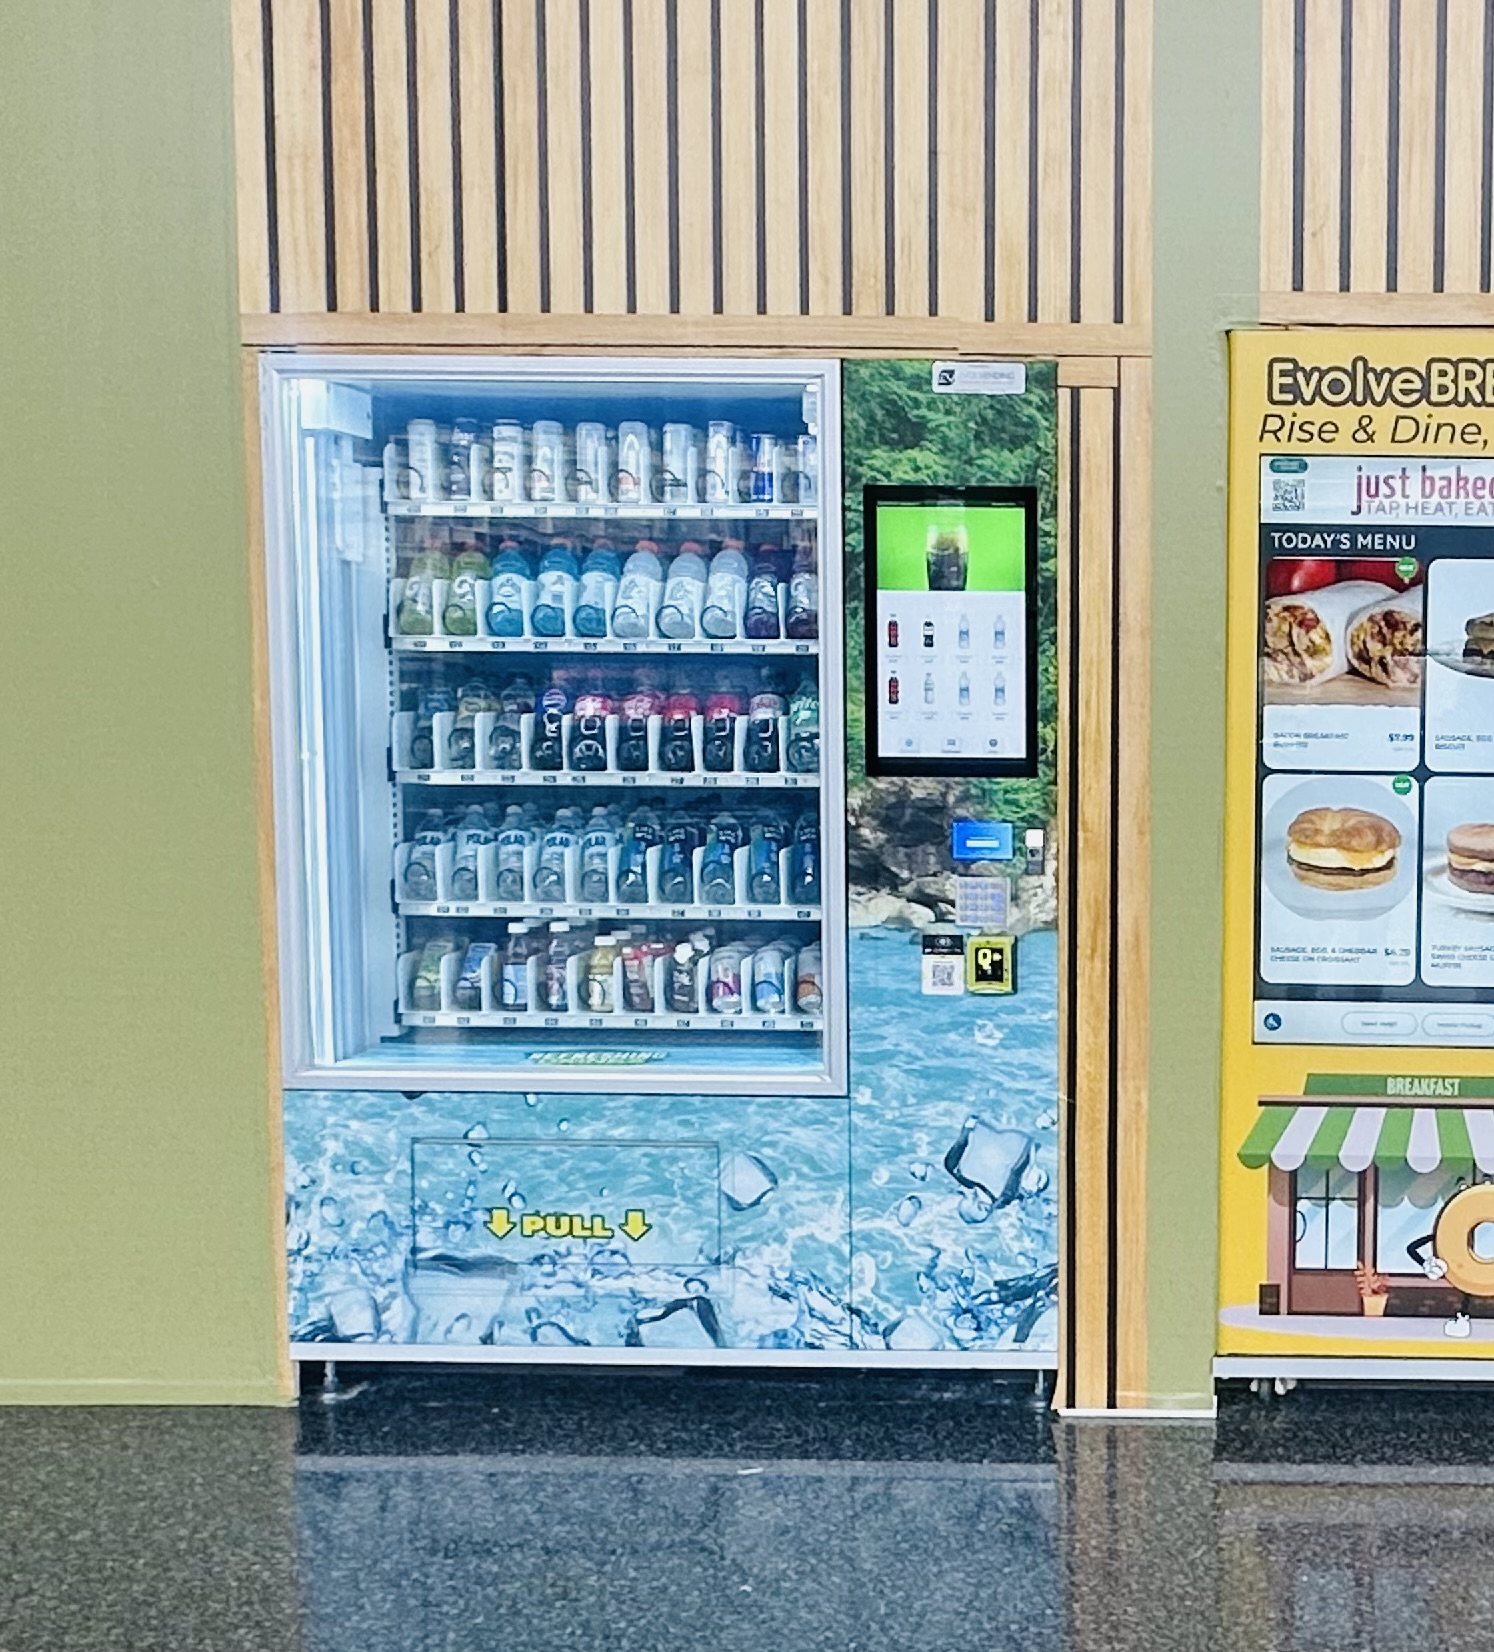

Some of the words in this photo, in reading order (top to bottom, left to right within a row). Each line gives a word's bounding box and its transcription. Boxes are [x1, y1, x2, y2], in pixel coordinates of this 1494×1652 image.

[1258, 411, 1339, 445] Rise
[1351, 415, 1377, 445] &
[1390, 413, 1490, 452] Dine,
[1351, 465, 1410, 516] just
[1271, 531, 1351, 551] TODAY'S
[1357, 532, 1417, 551] MENU
[1386, 1076, 1461, 1096] BREAKFAST
[520, 1213, 615, 1240] PULL
